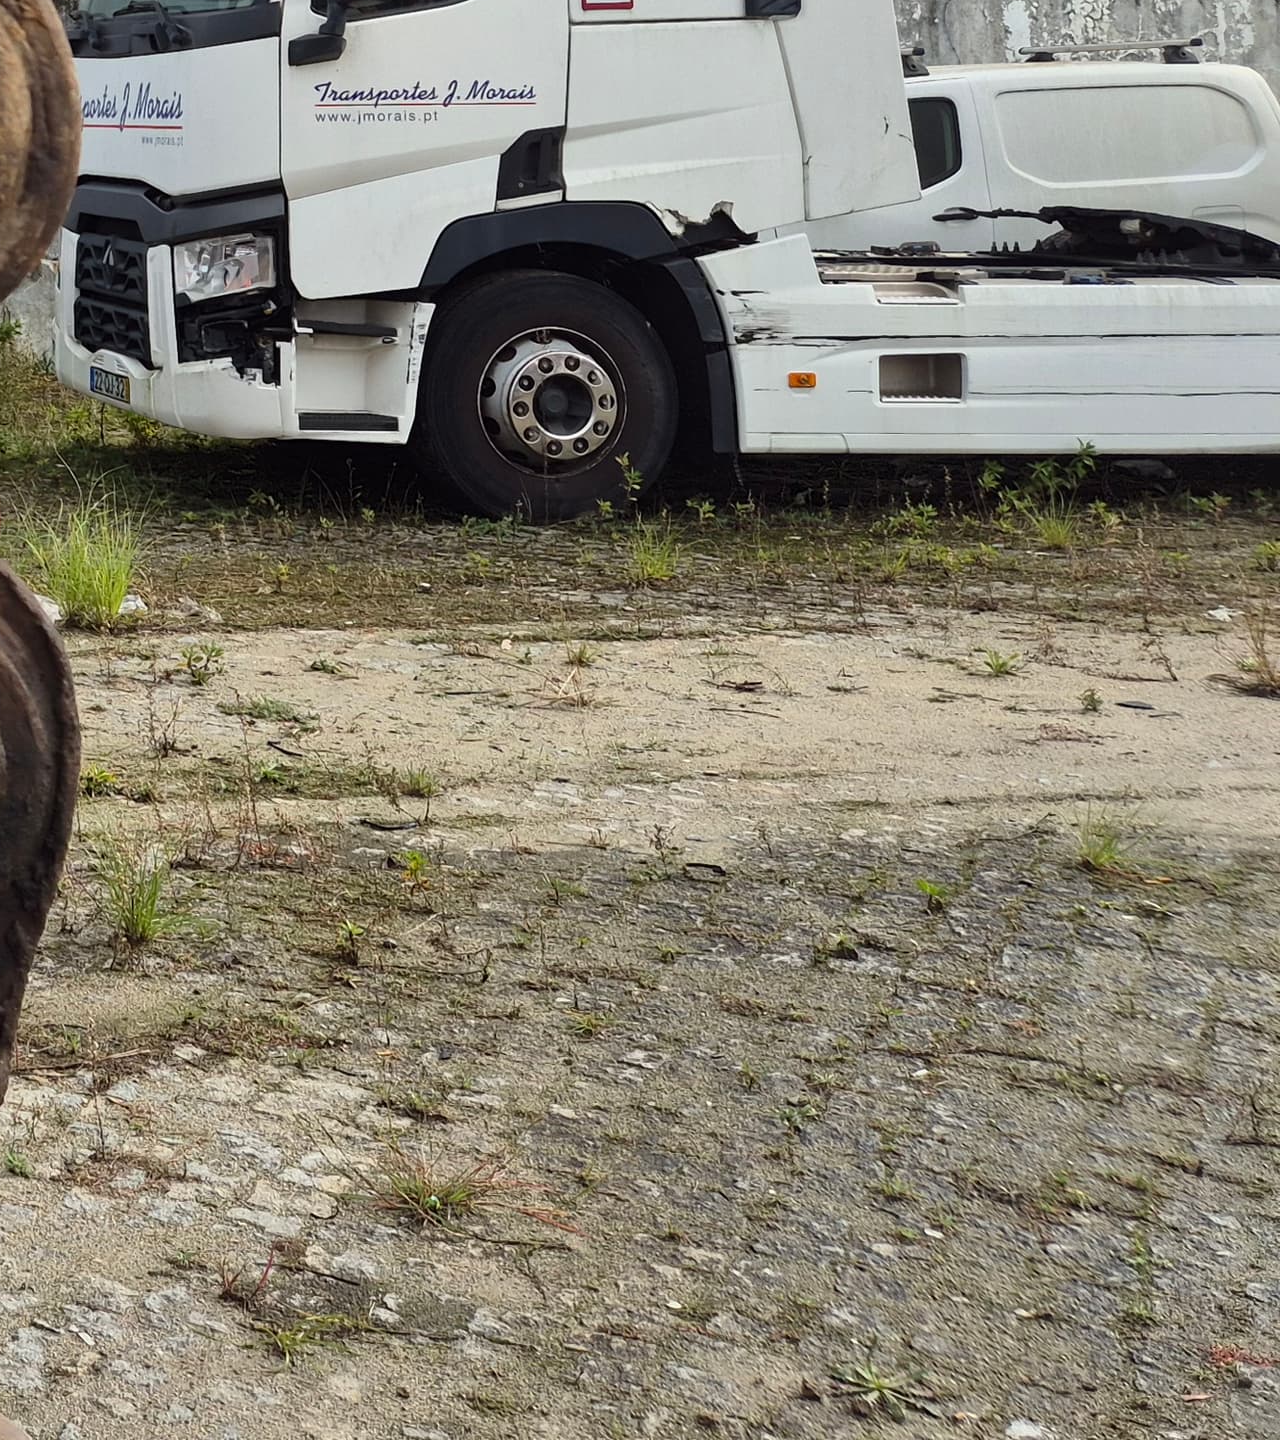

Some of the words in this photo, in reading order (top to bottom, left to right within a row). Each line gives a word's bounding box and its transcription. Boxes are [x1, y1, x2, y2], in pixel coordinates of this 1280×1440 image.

[82, 84, 118, 119] portes
[120, 81, 132, 132] J.
[133, 81, 183, 120] Morais
[314, 81, 439, 108] Transportes
[442, 80, 461, 108] J.
[464, 79, 536, 101] Morais
[314, 110, 438, 125] www.jmorais.pt
